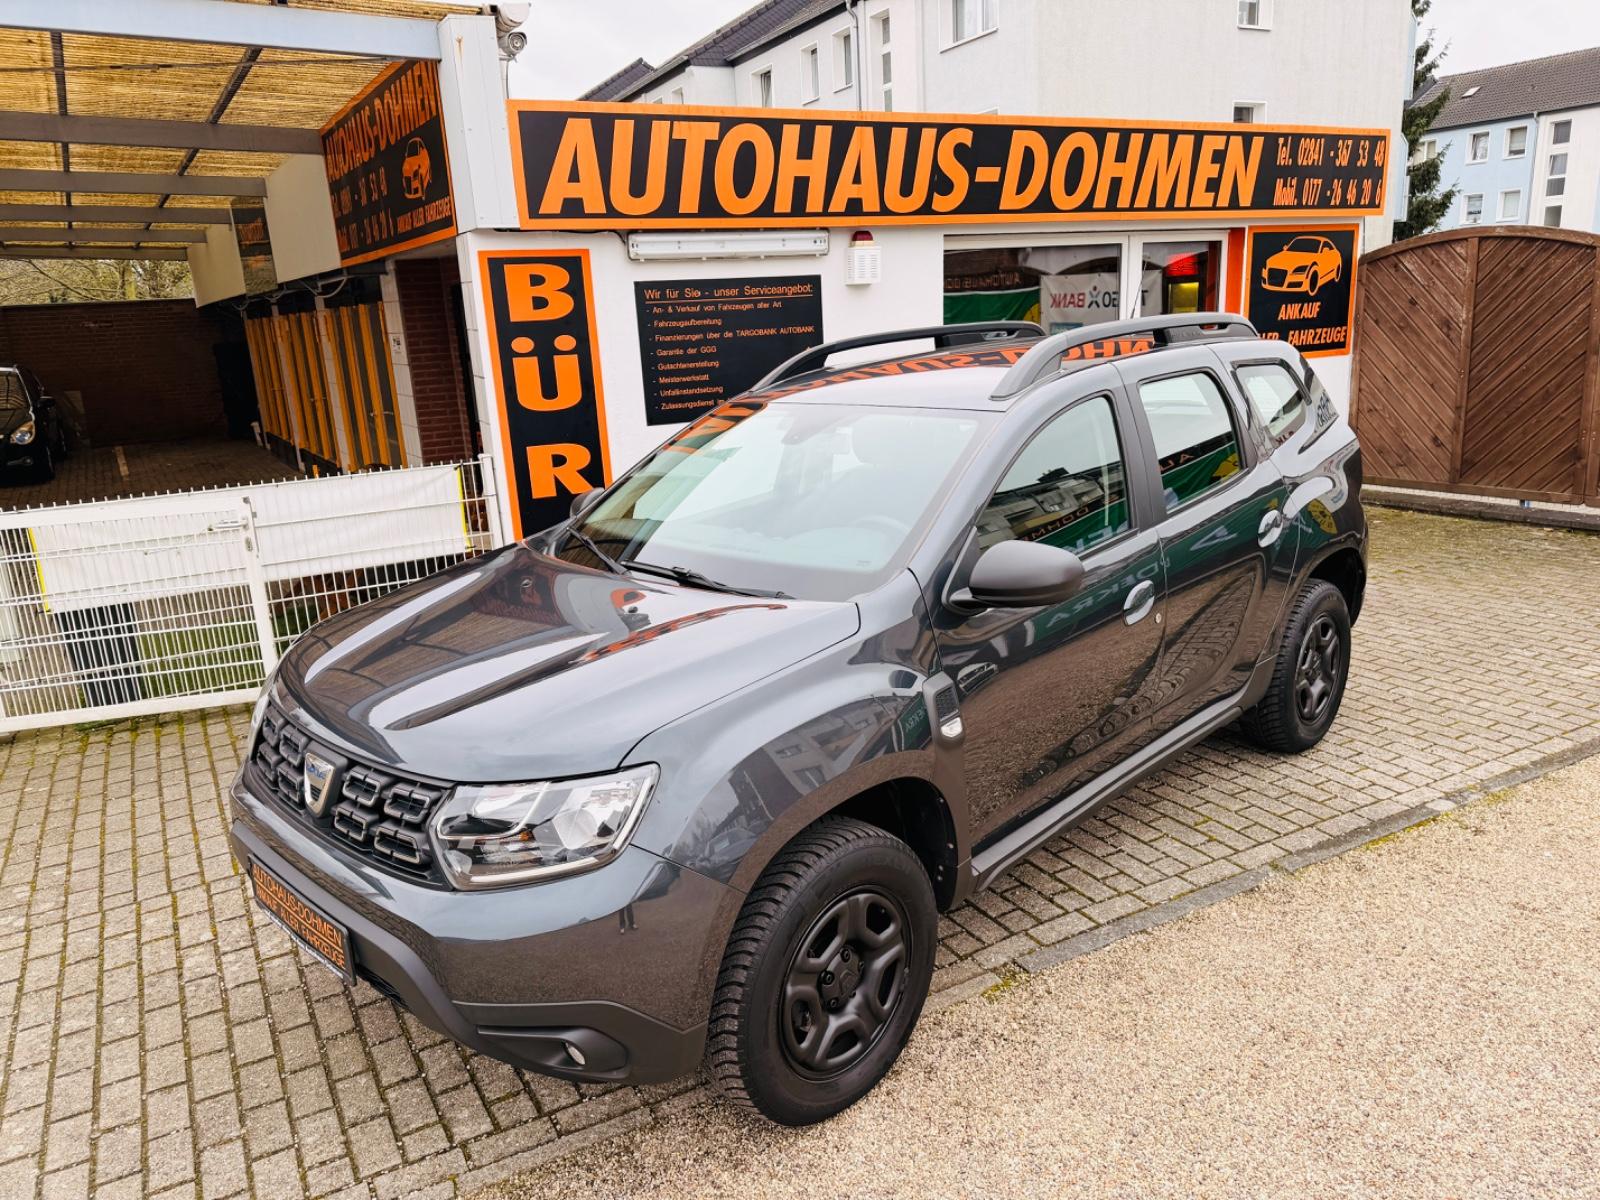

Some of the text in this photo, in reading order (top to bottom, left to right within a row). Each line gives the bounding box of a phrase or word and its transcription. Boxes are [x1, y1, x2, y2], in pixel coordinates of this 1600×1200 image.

[325, 61, 437, 182] AUTOHAUS-DOHMEN
[1276, 136, 1293, 167] Tel.
[1297, 137, 1325, 167] 02841
[1335, 139, 1353, 167] 367
[1356, 139, 1370, 167] 53
[1374, 140, 1385, 167] 48
[538, 117, 1265, 217] AUTOHAUS-DOHMEN
[1273, 176, 1298, 206] Mobil.
[1302, 178, 1323, 206] 0177
[1346, 179, 1358, 206] 46
[1360, 179, 1372, 206] 20
[1375, 179, 1382, 206] 6
[644, 288, 661, 300] Wir
[666, 287, 679, 299] für
[684, 287, 701, 298] Sie
[714, 287, 739, 297] unser
[744, 283, 813, 297] Serviceangebot:
[676, 304, 701, 313] Verkauf
[718, 302, 754, 312] Fahrzeugen
[757, 301, 770, 310] aller
[772, 301, 782, 309] Art
[1278, 301, 1322, 321] ANKAUF
[654, 317, 722, 328] Fahrzeugaufbereitung
[655, 333, 704, 343] Finanzierungen
[706, 330, 721, 340] über
[736, 327, 777, 337] TARGOBANK
[779, 325, 815, 335] AUTOBANK
[1287, 325, 1348, 347] FAHRZEUGE
[252, 863, 342, 947] AUTOHAUS-DOHMEN
